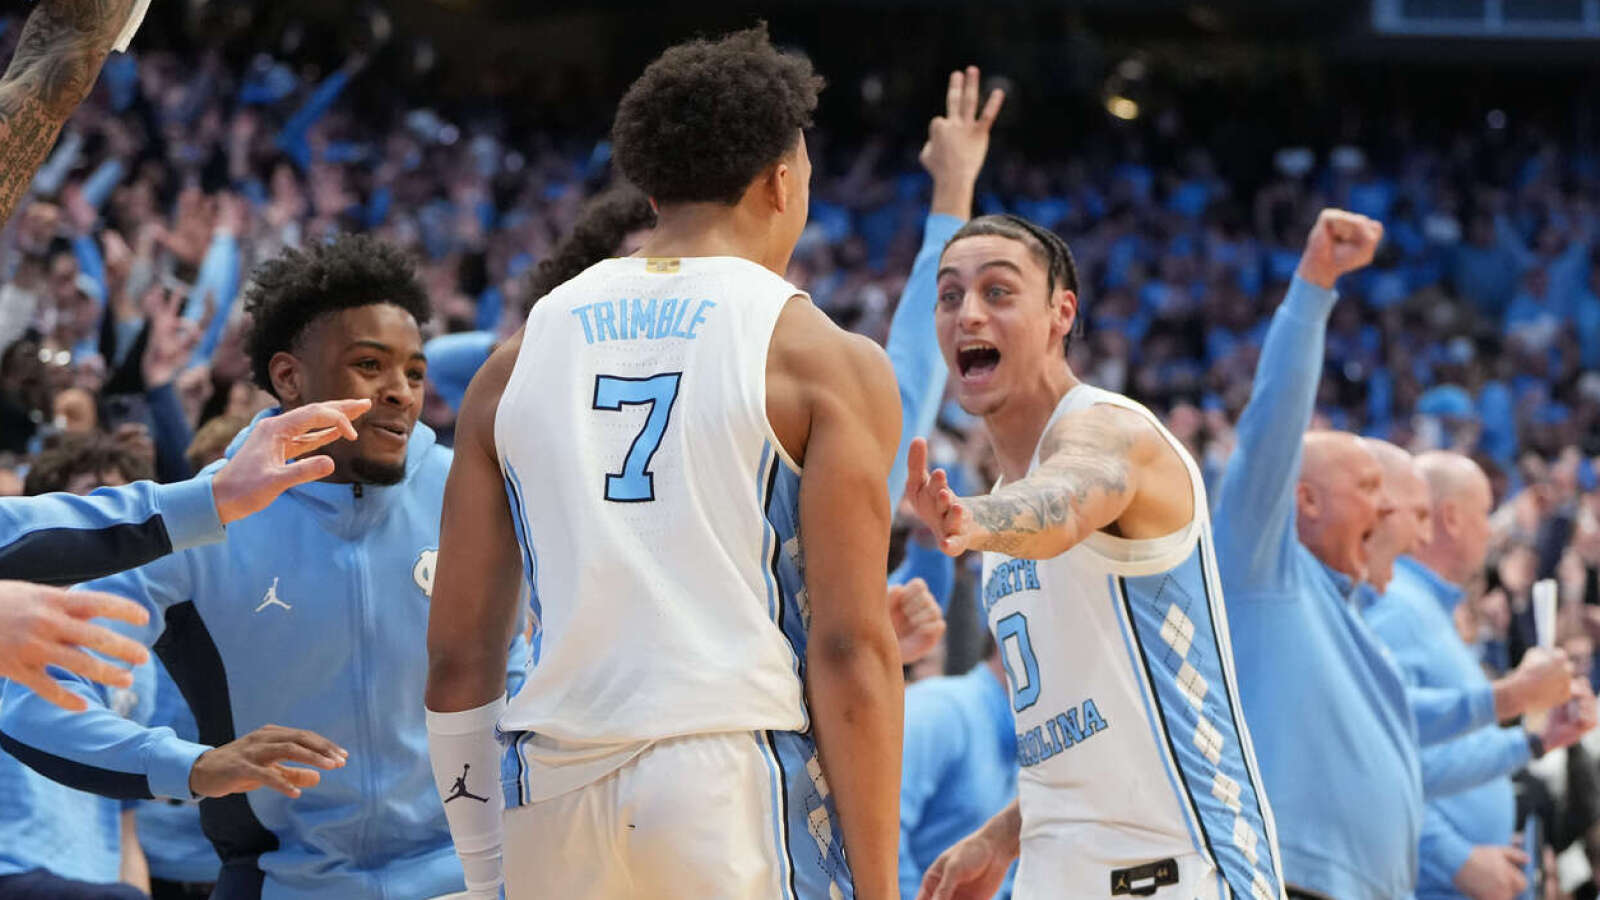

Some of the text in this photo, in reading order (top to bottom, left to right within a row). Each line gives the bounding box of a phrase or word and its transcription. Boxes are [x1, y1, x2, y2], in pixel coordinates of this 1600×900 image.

[571, 298, 717, 344] TRIMBLE
[592, 371, 682, 501] 7
[985, 559, 1041, 609] ORTH
[1016, 698, 1109, 767] ROLINA
